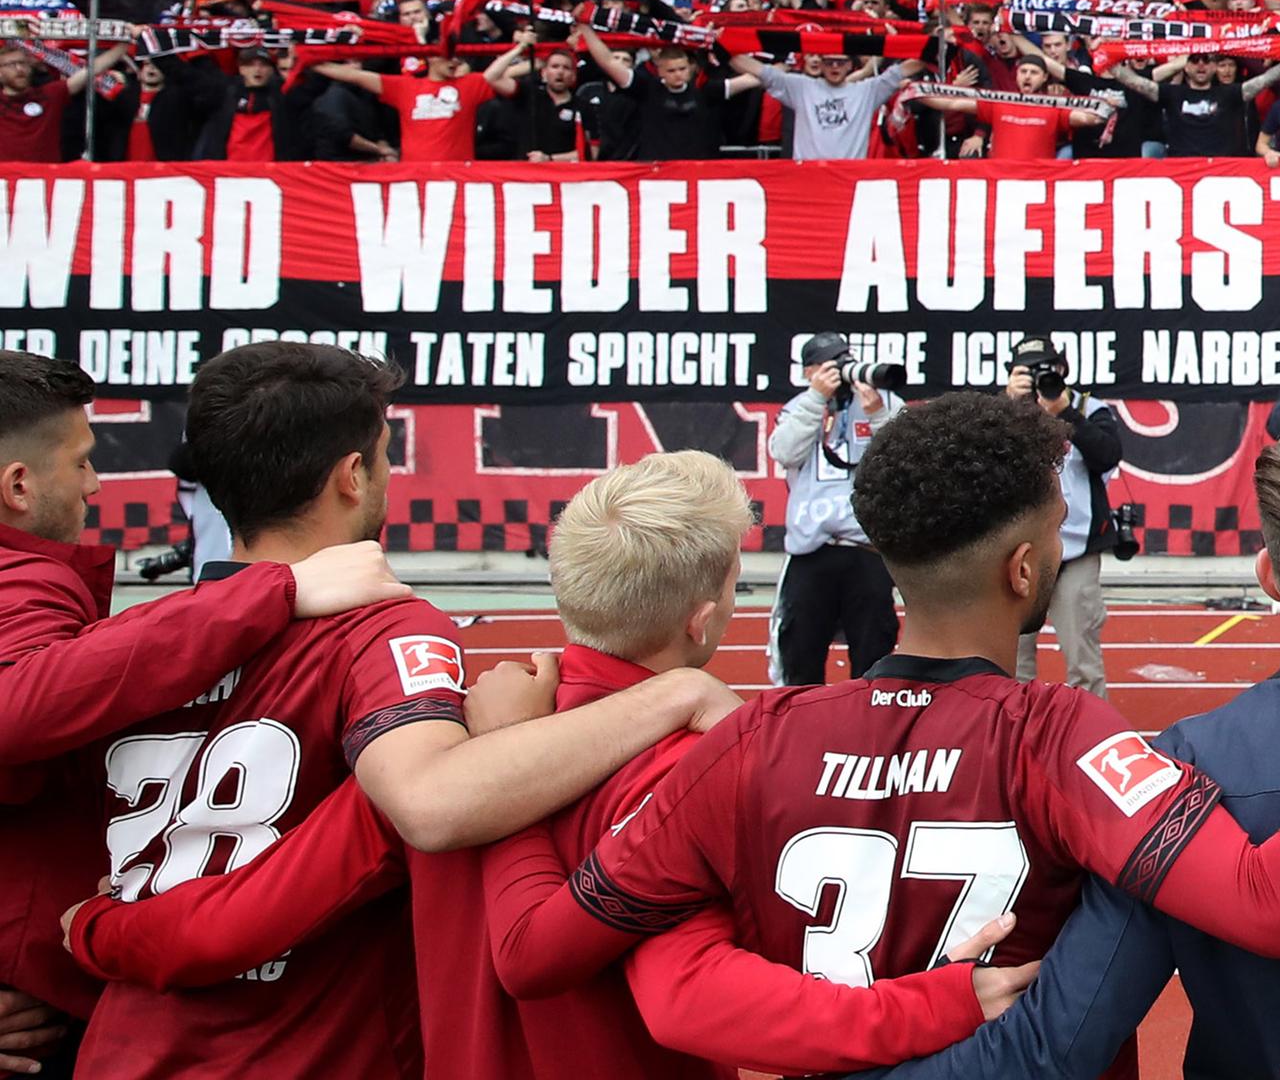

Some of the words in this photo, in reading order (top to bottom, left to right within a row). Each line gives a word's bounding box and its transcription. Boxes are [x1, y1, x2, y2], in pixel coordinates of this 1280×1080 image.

[917, 83, 970, 99] Ultras
[0, 176, 283, 312] WIRD
[349, 177, 768, 314] WIEDER
[80, 329, 200, 385] DEINE
[409, 331, 546, 388] TATEN
[566, 331, 770, 392] SPRICHT,
[793, 495, 852, 525] FOT
[870, 690, 896, 708] Der
[897, 689, 932, 708] Club
[815, 748, 963, 801] TILLMAN
[775, 821, 1031, 989] 37
